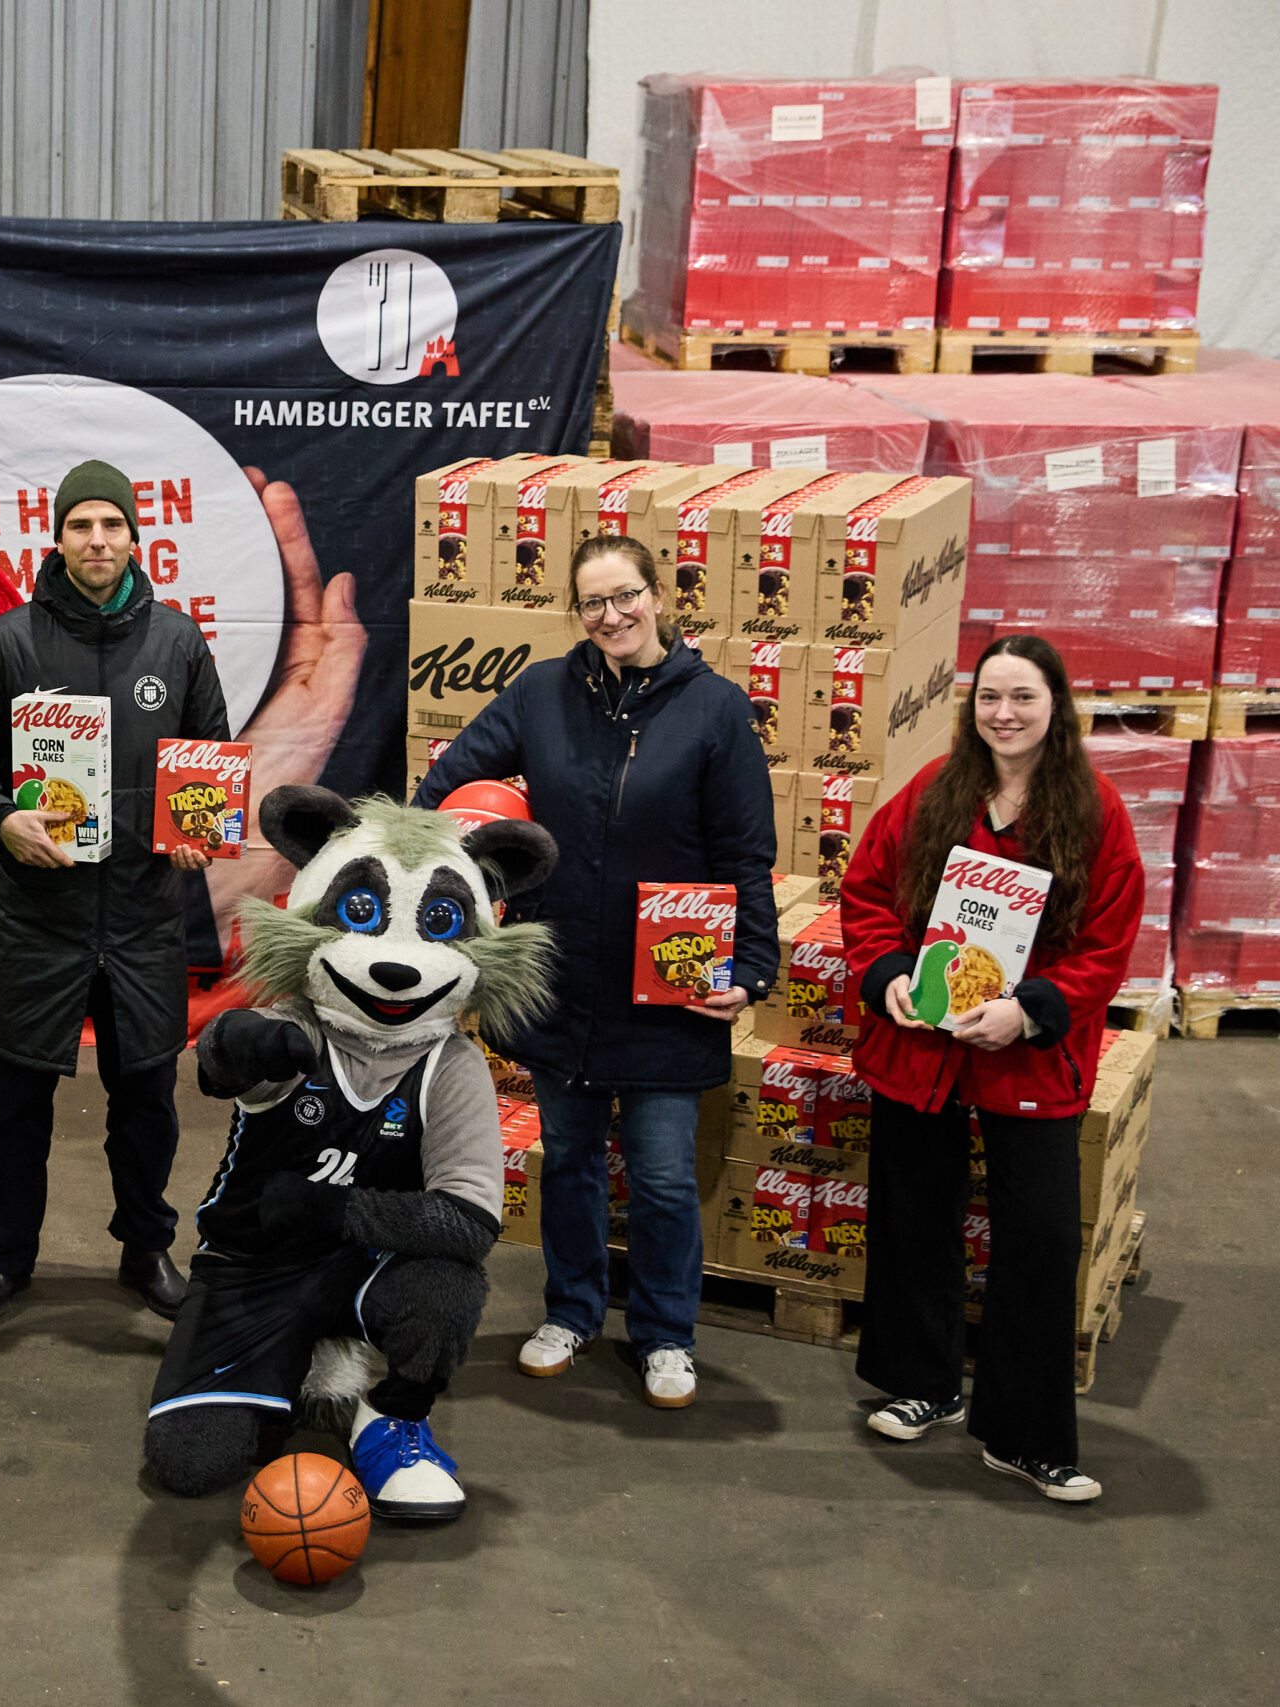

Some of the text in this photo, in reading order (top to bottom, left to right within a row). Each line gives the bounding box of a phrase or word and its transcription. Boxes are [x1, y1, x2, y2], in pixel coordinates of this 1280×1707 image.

[234, 400, 433, 428] HAMBURGER
[442, 402, 530, 429] TAFEL
[424, 582, 479, 603] Kellogg's
[501, 587, 557, 608] Kellogg's
[742, 619, 801, 636] Kellogg's
[825, 624, 886, 642] Kellogg's
[32, 738, 65, 752] CORN
[32, 752, 65, 763] FLAKES
[813, 753, 874, 775] Kellogg's
[78, 827, 98, 838] WIN
[960, 899, 999, 920] CORN
[956, 912, 995, 931] FLAKES
[307, 1148, 358, 1186] 24
[770, 1145, 849, 1176] Kellogg's
[764, 1250, 842, 1280] Kellogg's
